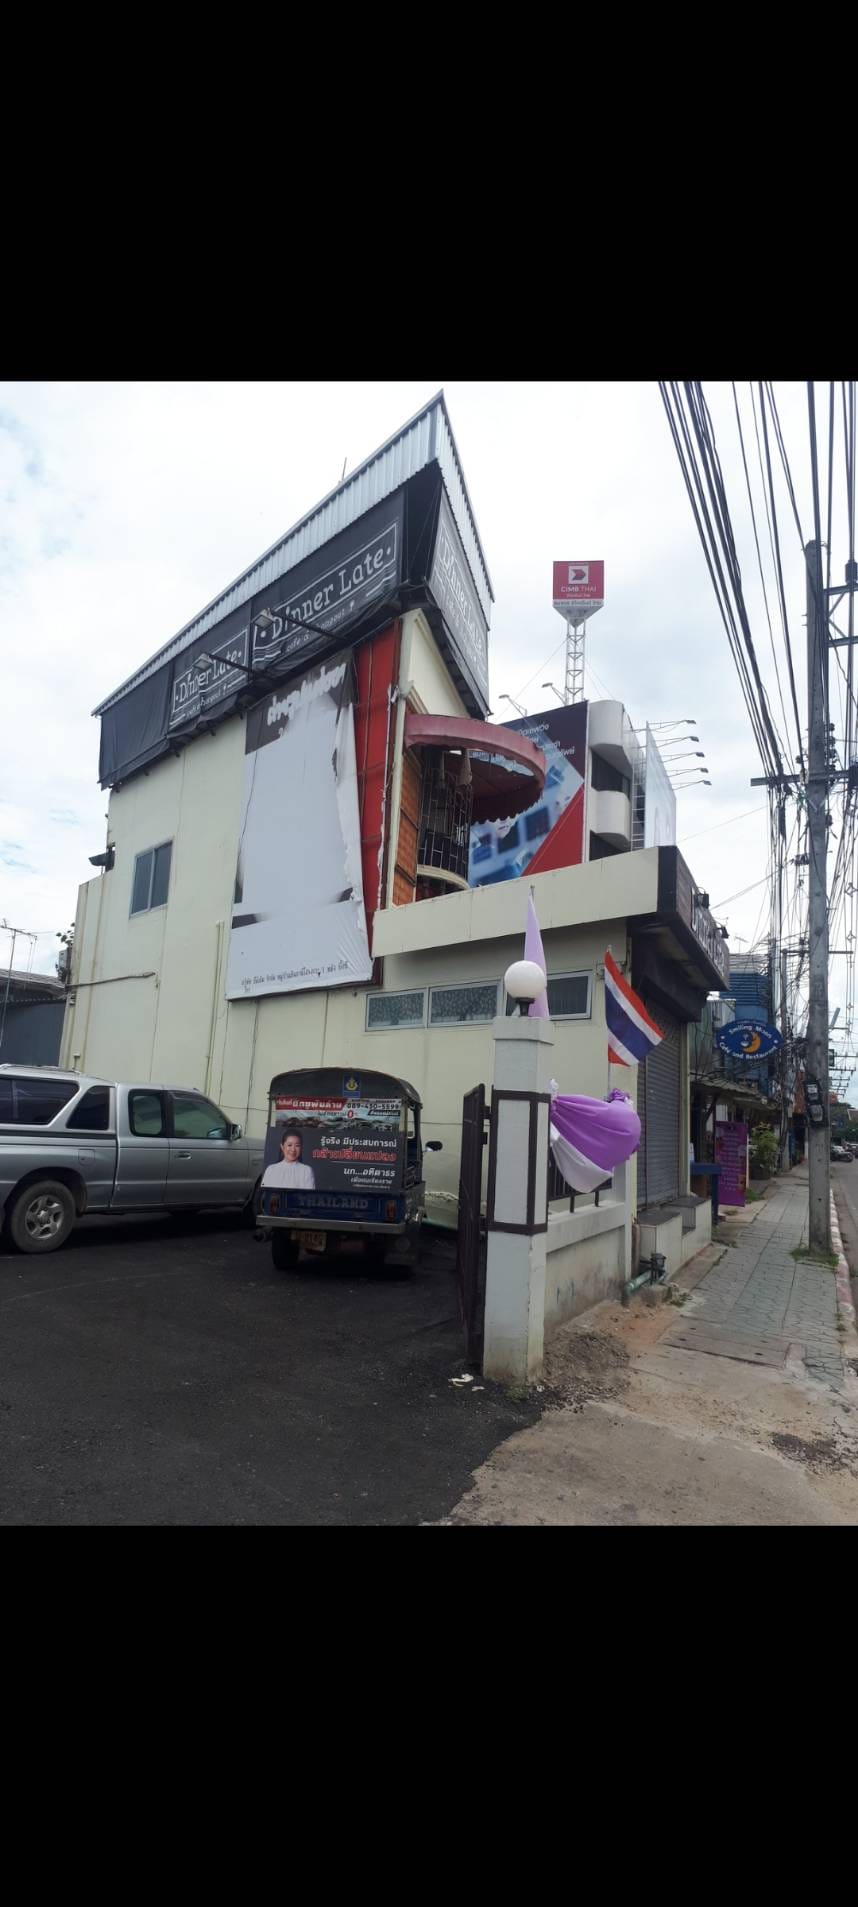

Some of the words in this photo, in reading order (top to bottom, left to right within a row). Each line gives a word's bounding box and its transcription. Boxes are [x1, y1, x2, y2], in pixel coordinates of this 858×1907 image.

[272, 582, 334, 639] Dinner
[339, 547, 384, 596] Late
[560, 585, 579, 593] CIMB
[581, 585, 597, 593] THAI
[728, 1024, 753, 1034] Smiling
[297, 1195, 369, 1209] THAILAND
